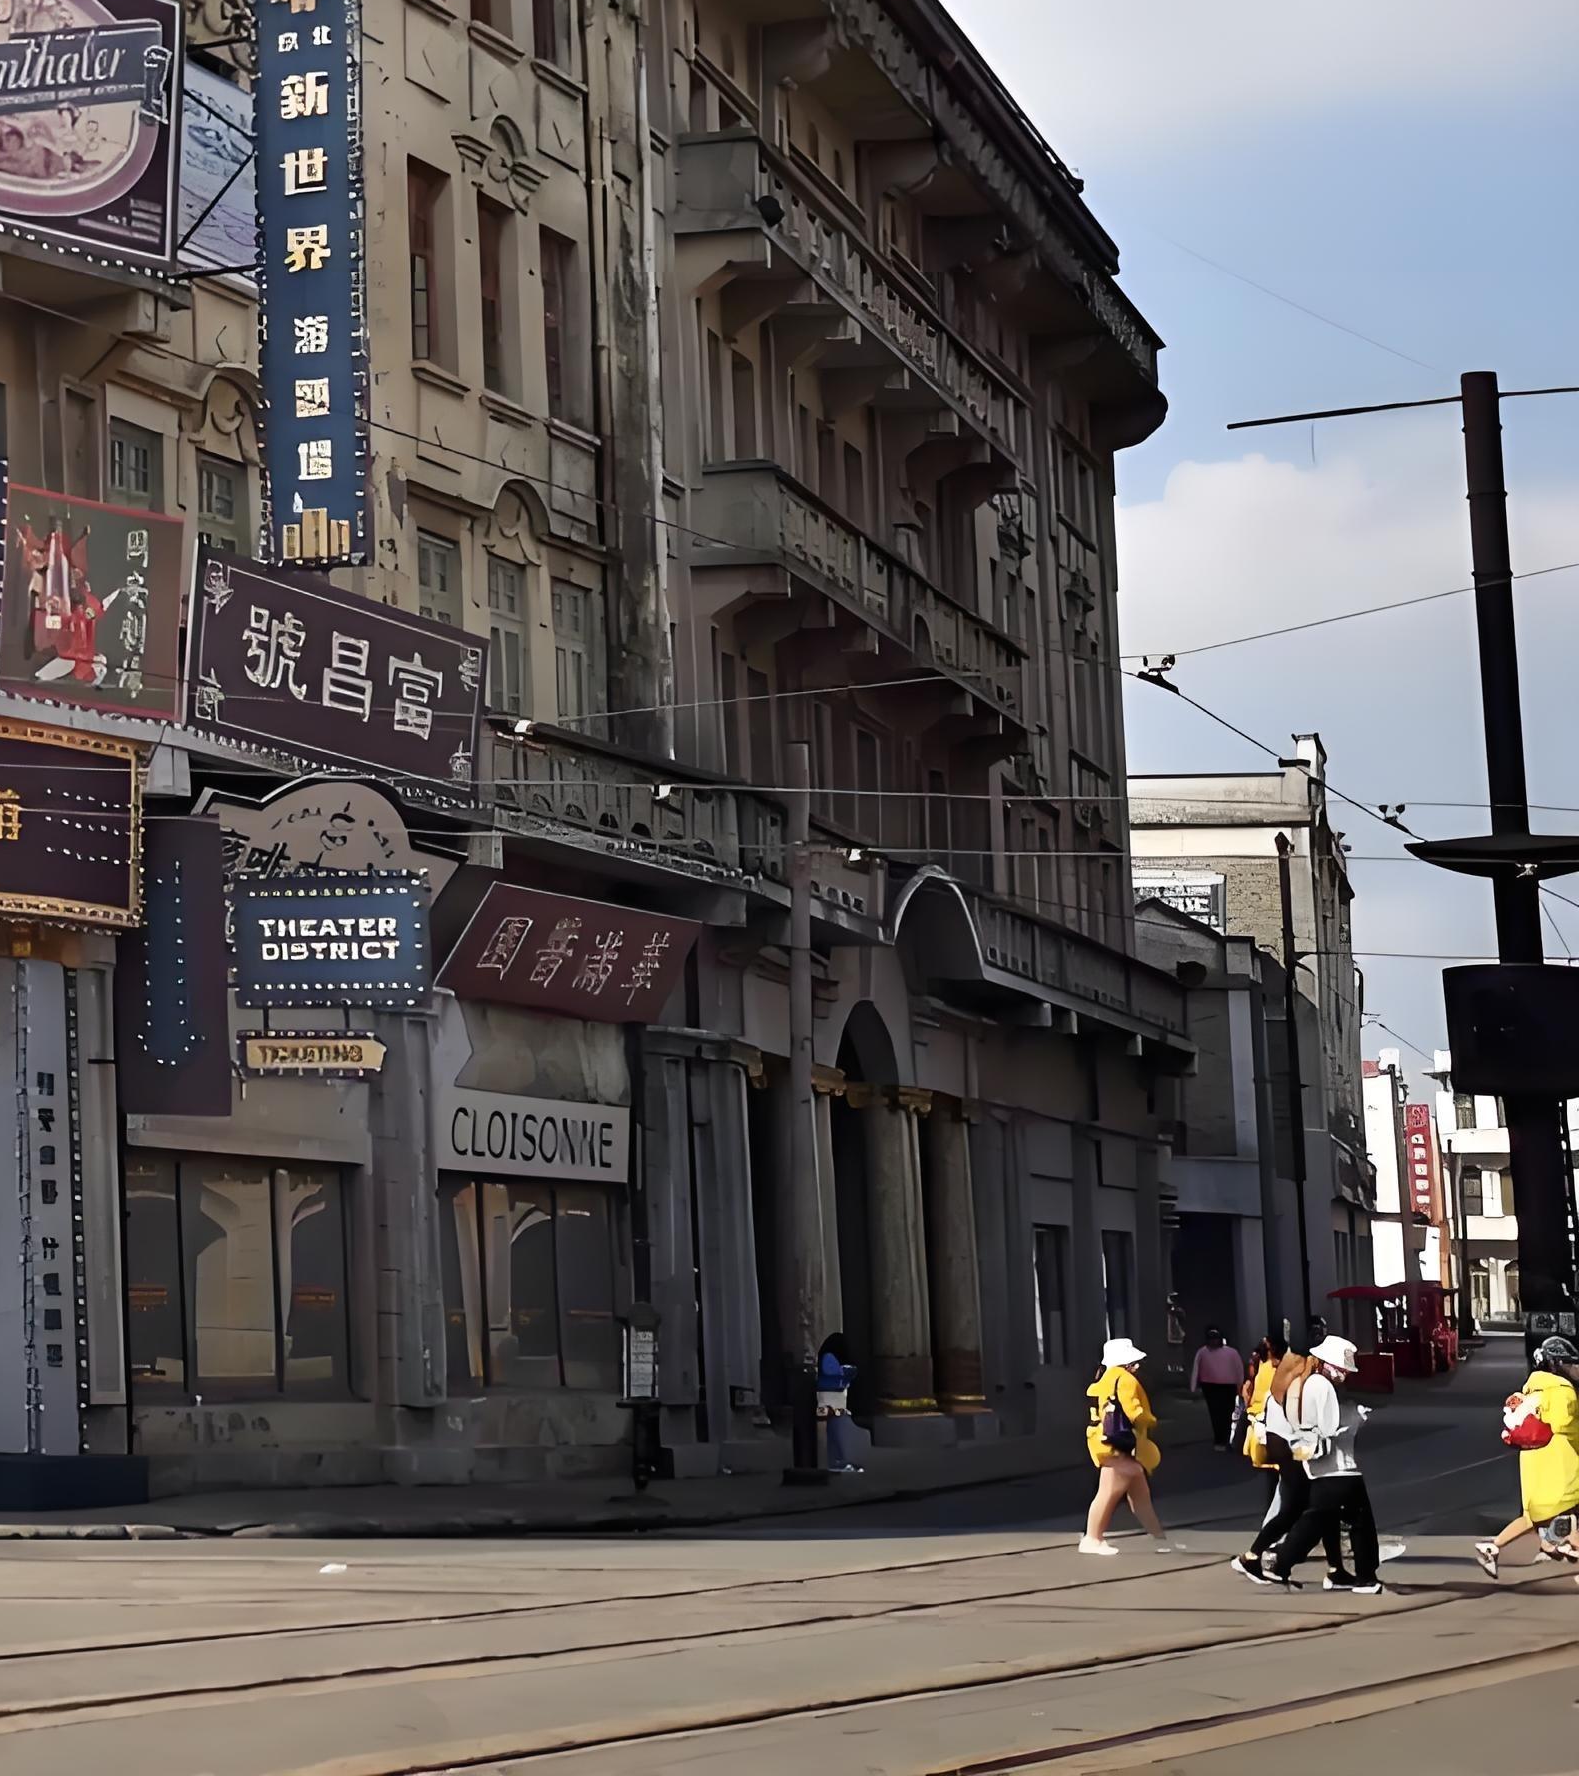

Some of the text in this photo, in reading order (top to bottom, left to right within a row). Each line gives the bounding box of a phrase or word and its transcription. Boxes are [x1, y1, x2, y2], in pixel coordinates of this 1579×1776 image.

[258, 916, 398, 938] THEATER
[261, 939, 402, 962] DISTRICT
[451, 1106, 615, 1169] CLOISONNE
